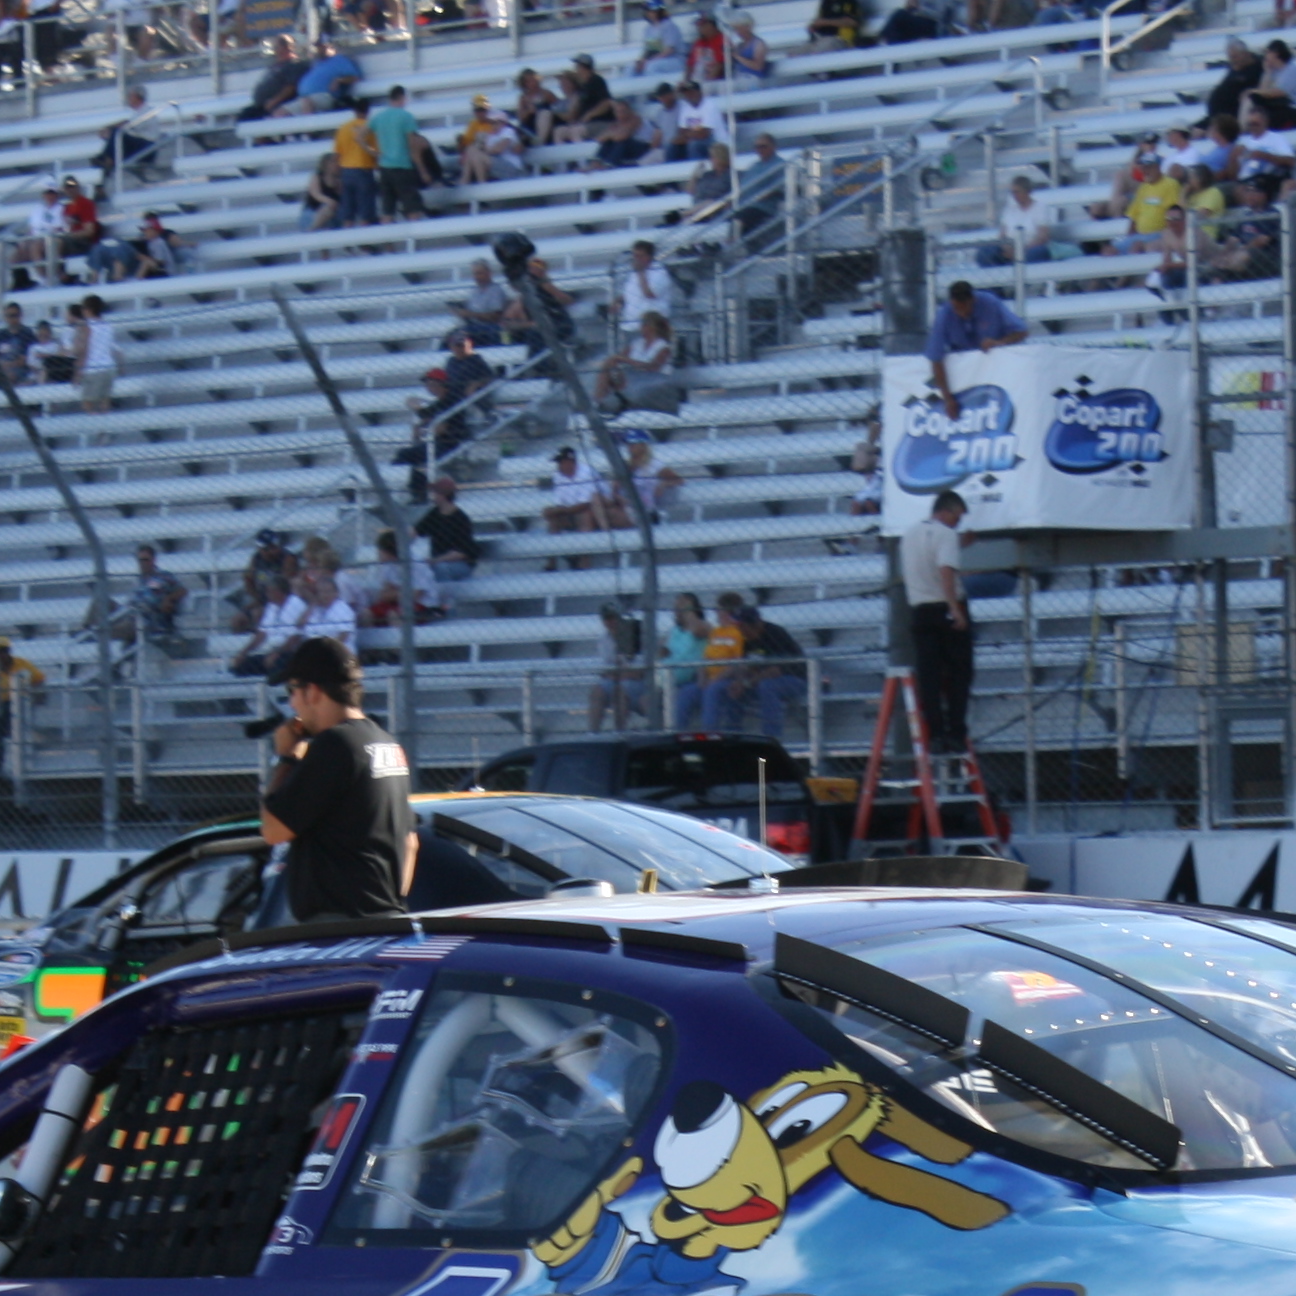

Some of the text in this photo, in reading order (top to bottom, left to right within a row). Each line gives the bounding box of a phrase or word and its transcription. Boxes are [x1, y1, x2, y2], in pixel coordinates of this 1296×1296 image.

[1057, 398, 1148, 431] Copart
[945, 434, 1016, 476] 200
[1095, 431, 1162, 462] 200
